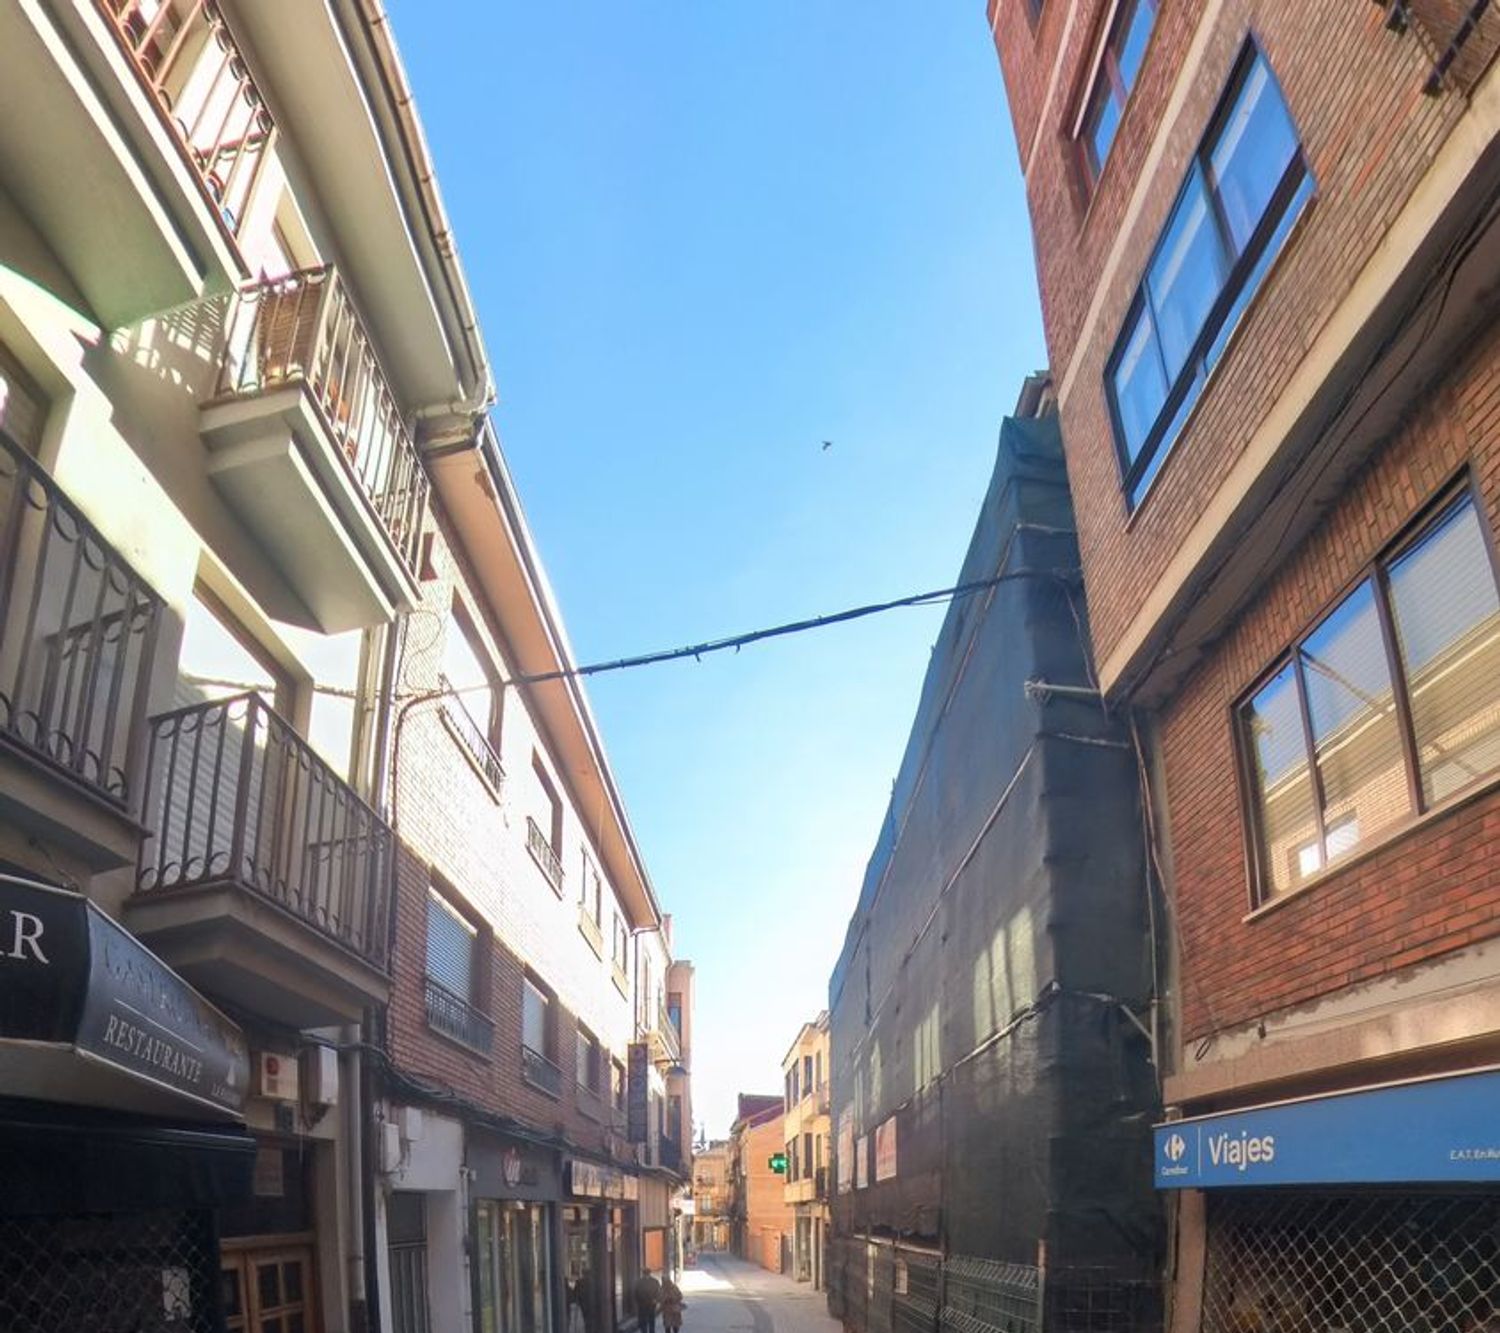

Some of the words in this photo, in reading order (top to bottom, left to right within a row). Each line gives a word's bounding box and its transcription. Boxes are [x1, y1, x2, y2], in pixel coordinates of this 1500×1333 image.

[0, 910, 49, 964] R
[103, 1014, 202, 1083] RESTAURANTE
[1208, 1130, 1275, 1171] Viajes
